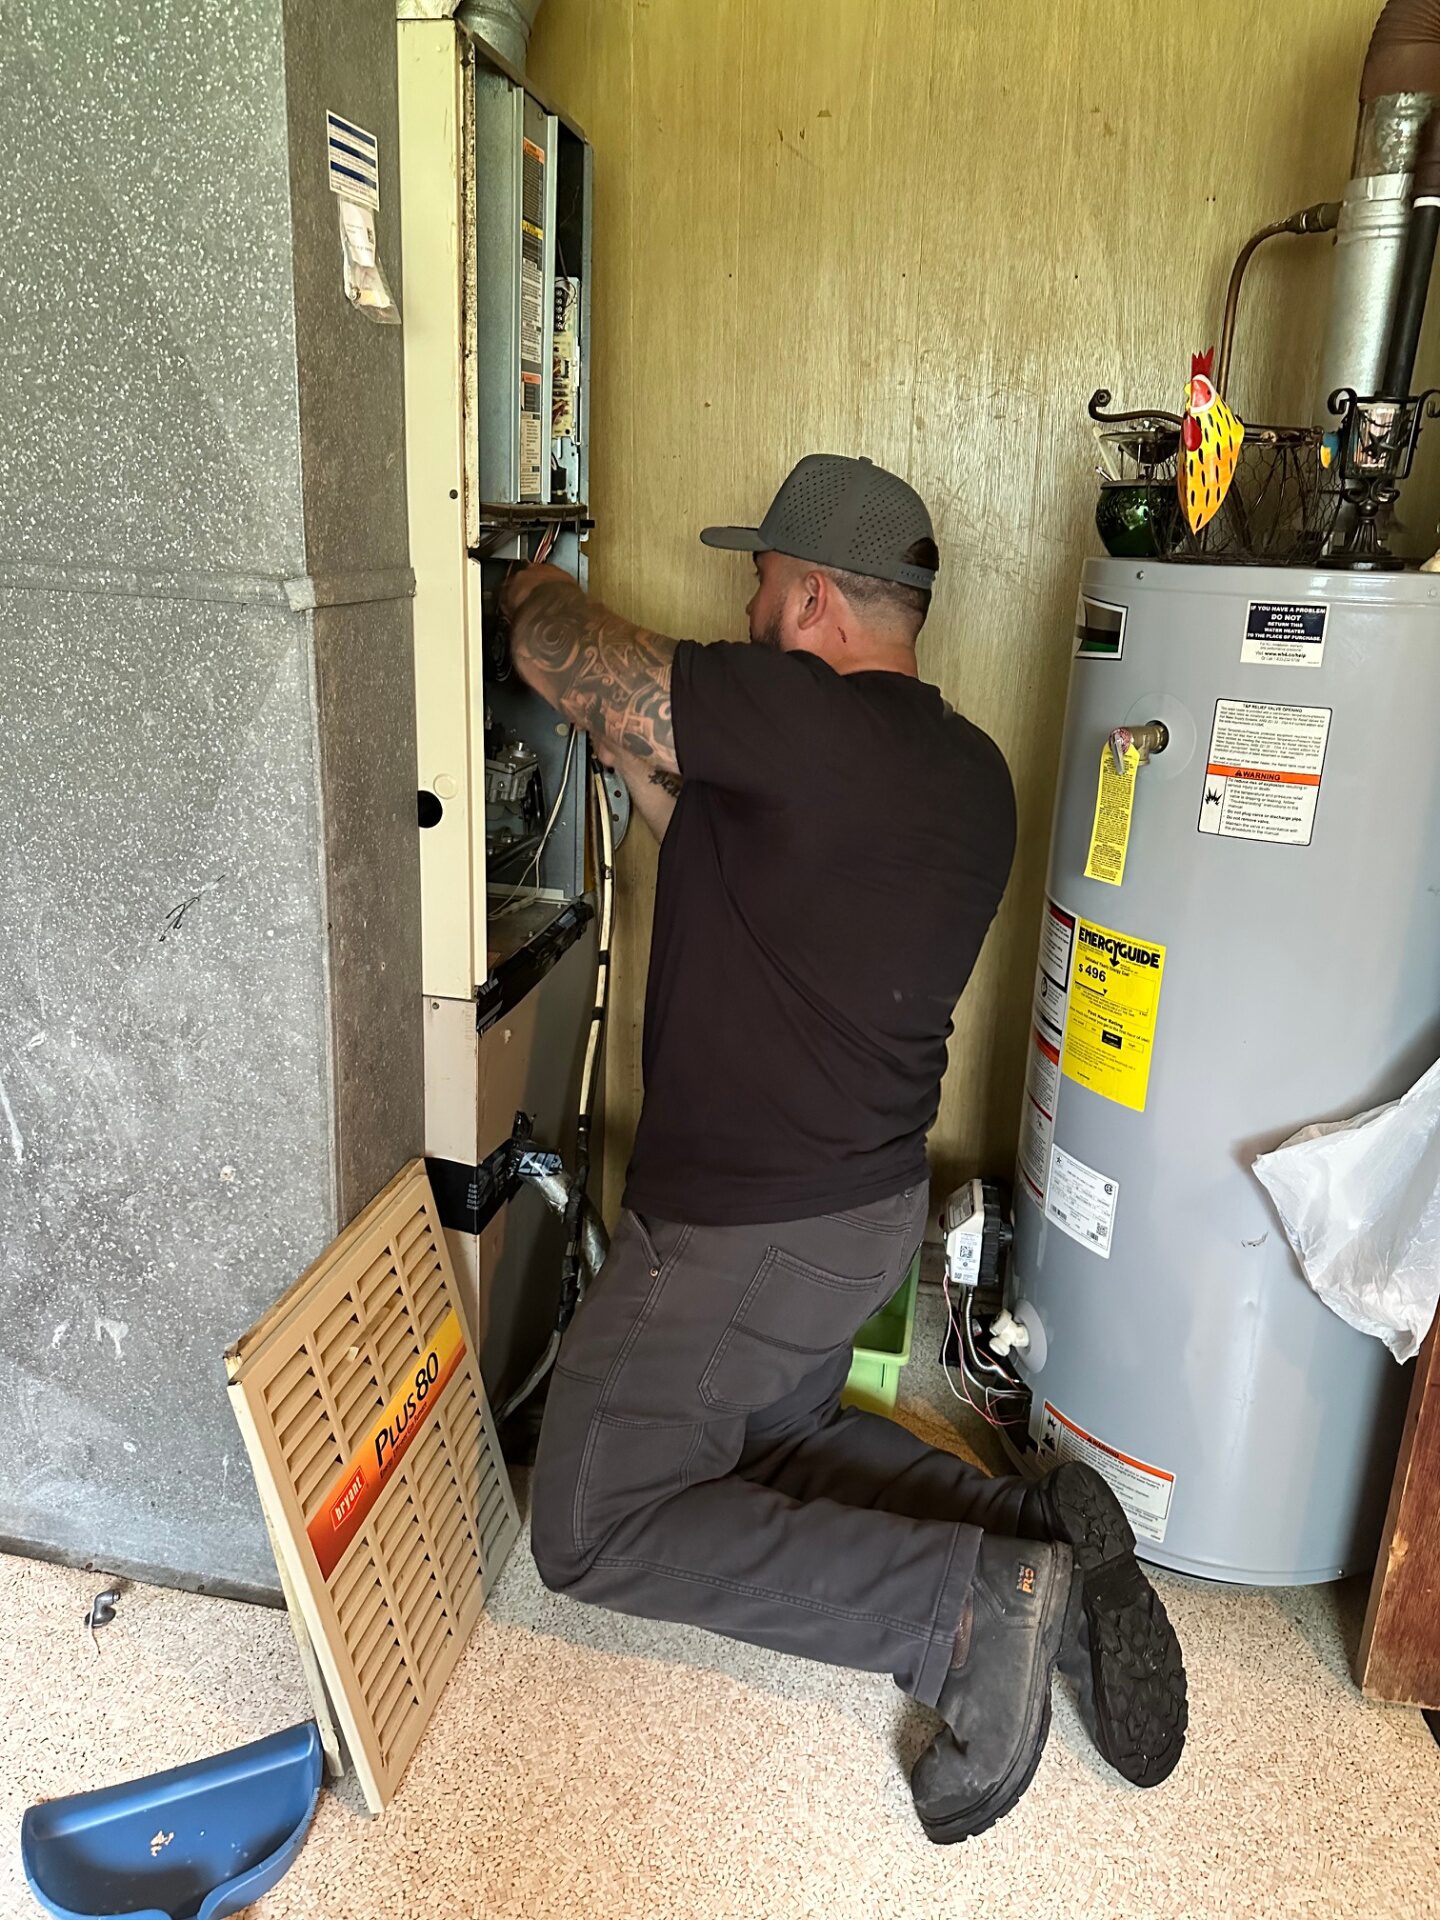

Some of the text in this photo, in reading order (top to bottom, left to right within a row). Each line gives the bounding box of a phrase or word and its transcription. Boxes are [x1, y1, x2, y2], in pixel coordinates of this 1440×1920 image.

[1244, 771, 1280, 780] WARNING
[1078, 963, 1083, 973] $
[1085, 965, 1106, 983] 496
[416, 1352, 438, 1401] 80
[335, 1476, 362, 1521] bryant
